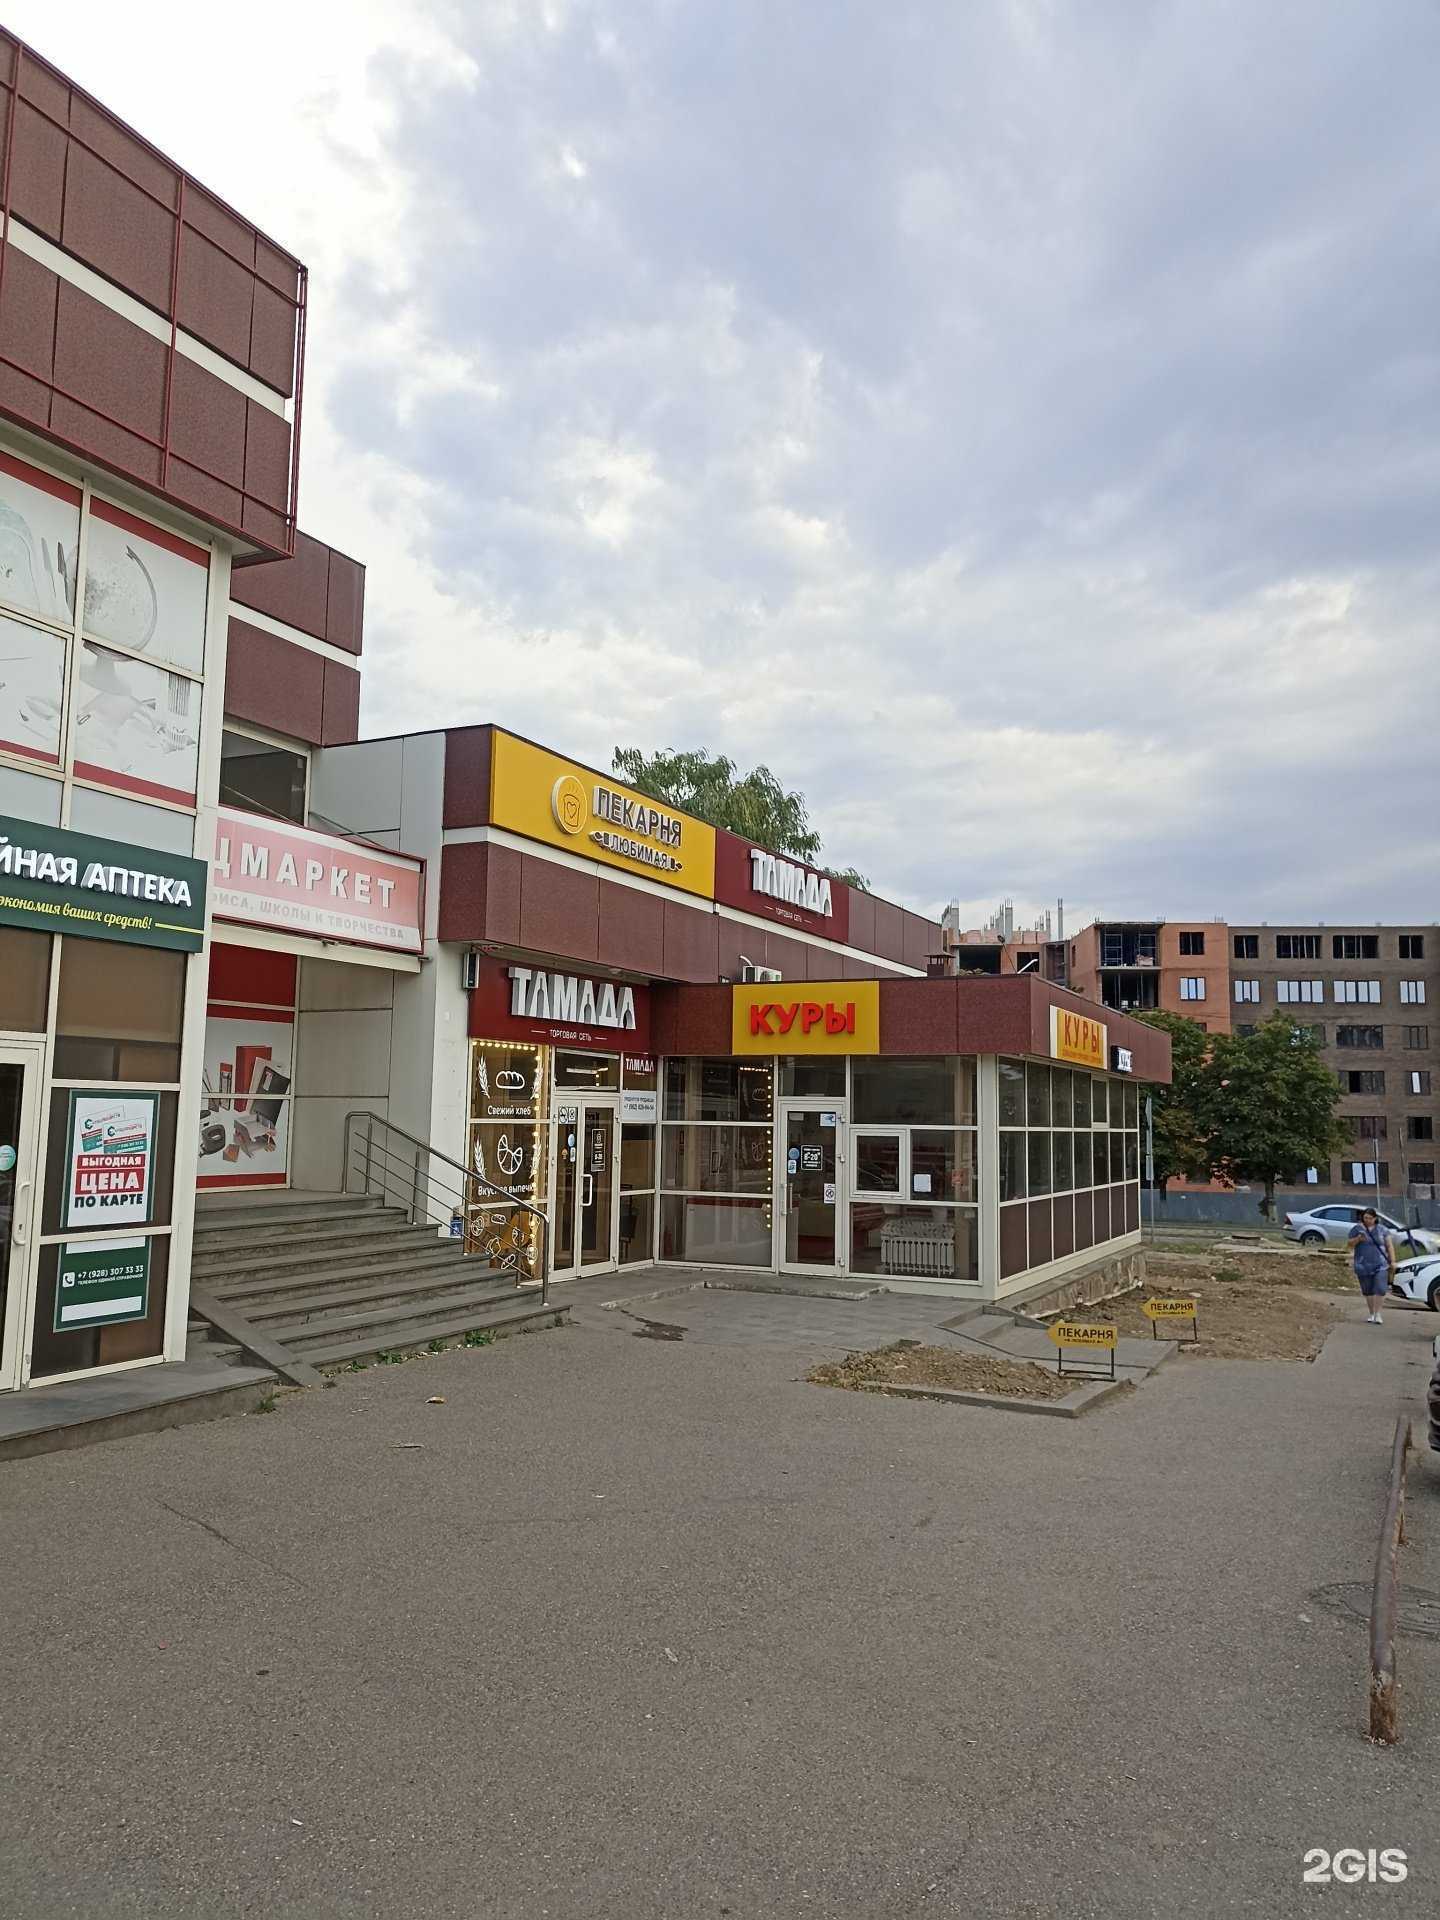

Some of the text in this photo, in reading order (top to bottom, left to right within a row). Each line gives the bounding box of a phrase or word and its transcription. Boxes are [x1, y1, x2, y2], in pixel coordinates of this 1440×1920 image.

[593, 786, 682, 848] ПЕКАРНЯ
[611, 833, 668, 868] ЛЮБИМАЯ
[81, 863, 192, 907] АПТЕКА
[751, 848, 832, 918] ТАМАДА
[62, 902, 102, 921] ваших
[103, 911, 152, 929] средств!
[259, 902, 310, 922] ШКОЛЫ
[315, 913, 324, 924] И
[327, 914, 405, 940] ТВОРЧЕСТВА
[508, 967, 637, 1030] ТАМАДА
[750, 1002, 856, 1035] КУРЫ
[549, 1029, 592, 1042] ТОРГОВАЯ СЕТЬ
[1063, 1013, 1100, 1056] КУРЫ
[625, 1057, 655, 1073] ТАМАДА
[487, 1104, 532, 1116] Свежий хлеб
[81, 1156, 142, 1168] ВЫГОДНАЯ
[80, 1171, 140, 1194] ЦЕНА
[74, 1194, 143, 1209] ПО КАРТЕ
[109, 1267, 123, 1276] 307
[1150, 1301, 1195, 1312] ПЕКАРНЯ
[1057, 1326, 1114, 1340] ПЕКАРНЯ
